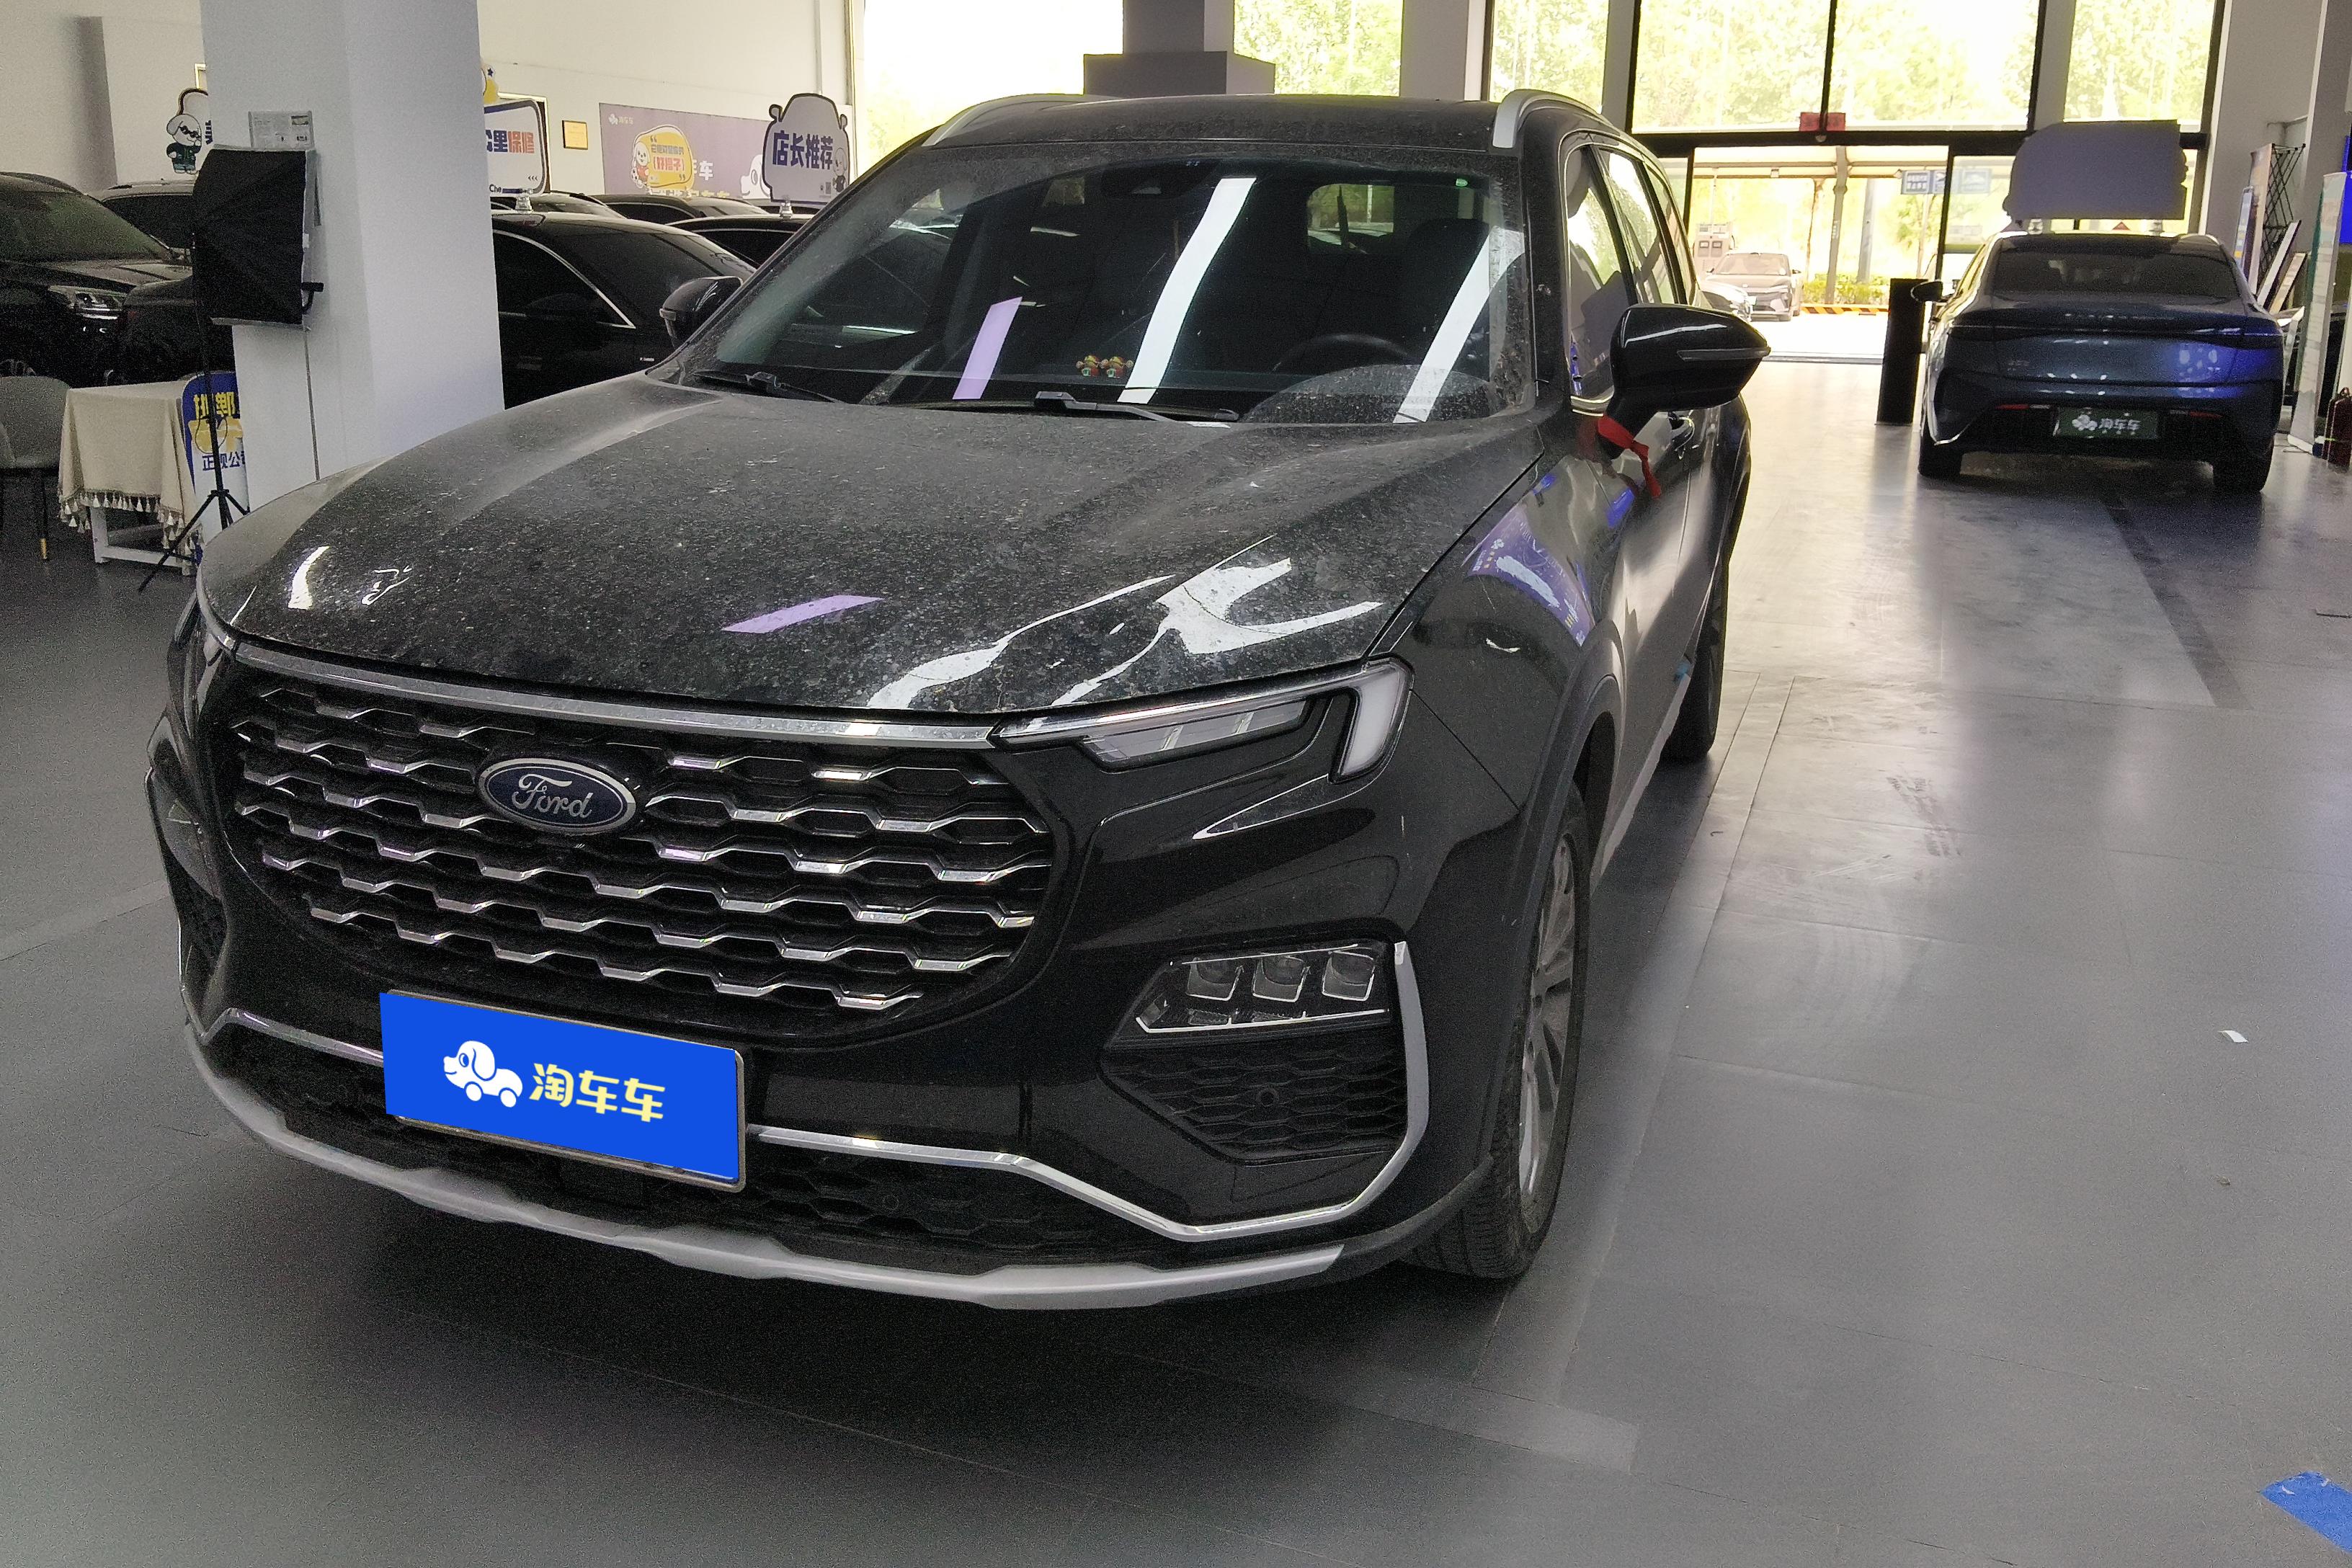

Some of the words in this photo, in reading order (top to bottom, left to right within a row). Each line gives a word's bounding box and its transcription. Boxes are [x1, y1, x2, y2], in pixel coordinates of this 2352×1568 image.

[772, 130, 834, 170] 店长推荐
[512, 773, 594, 819] Ford
